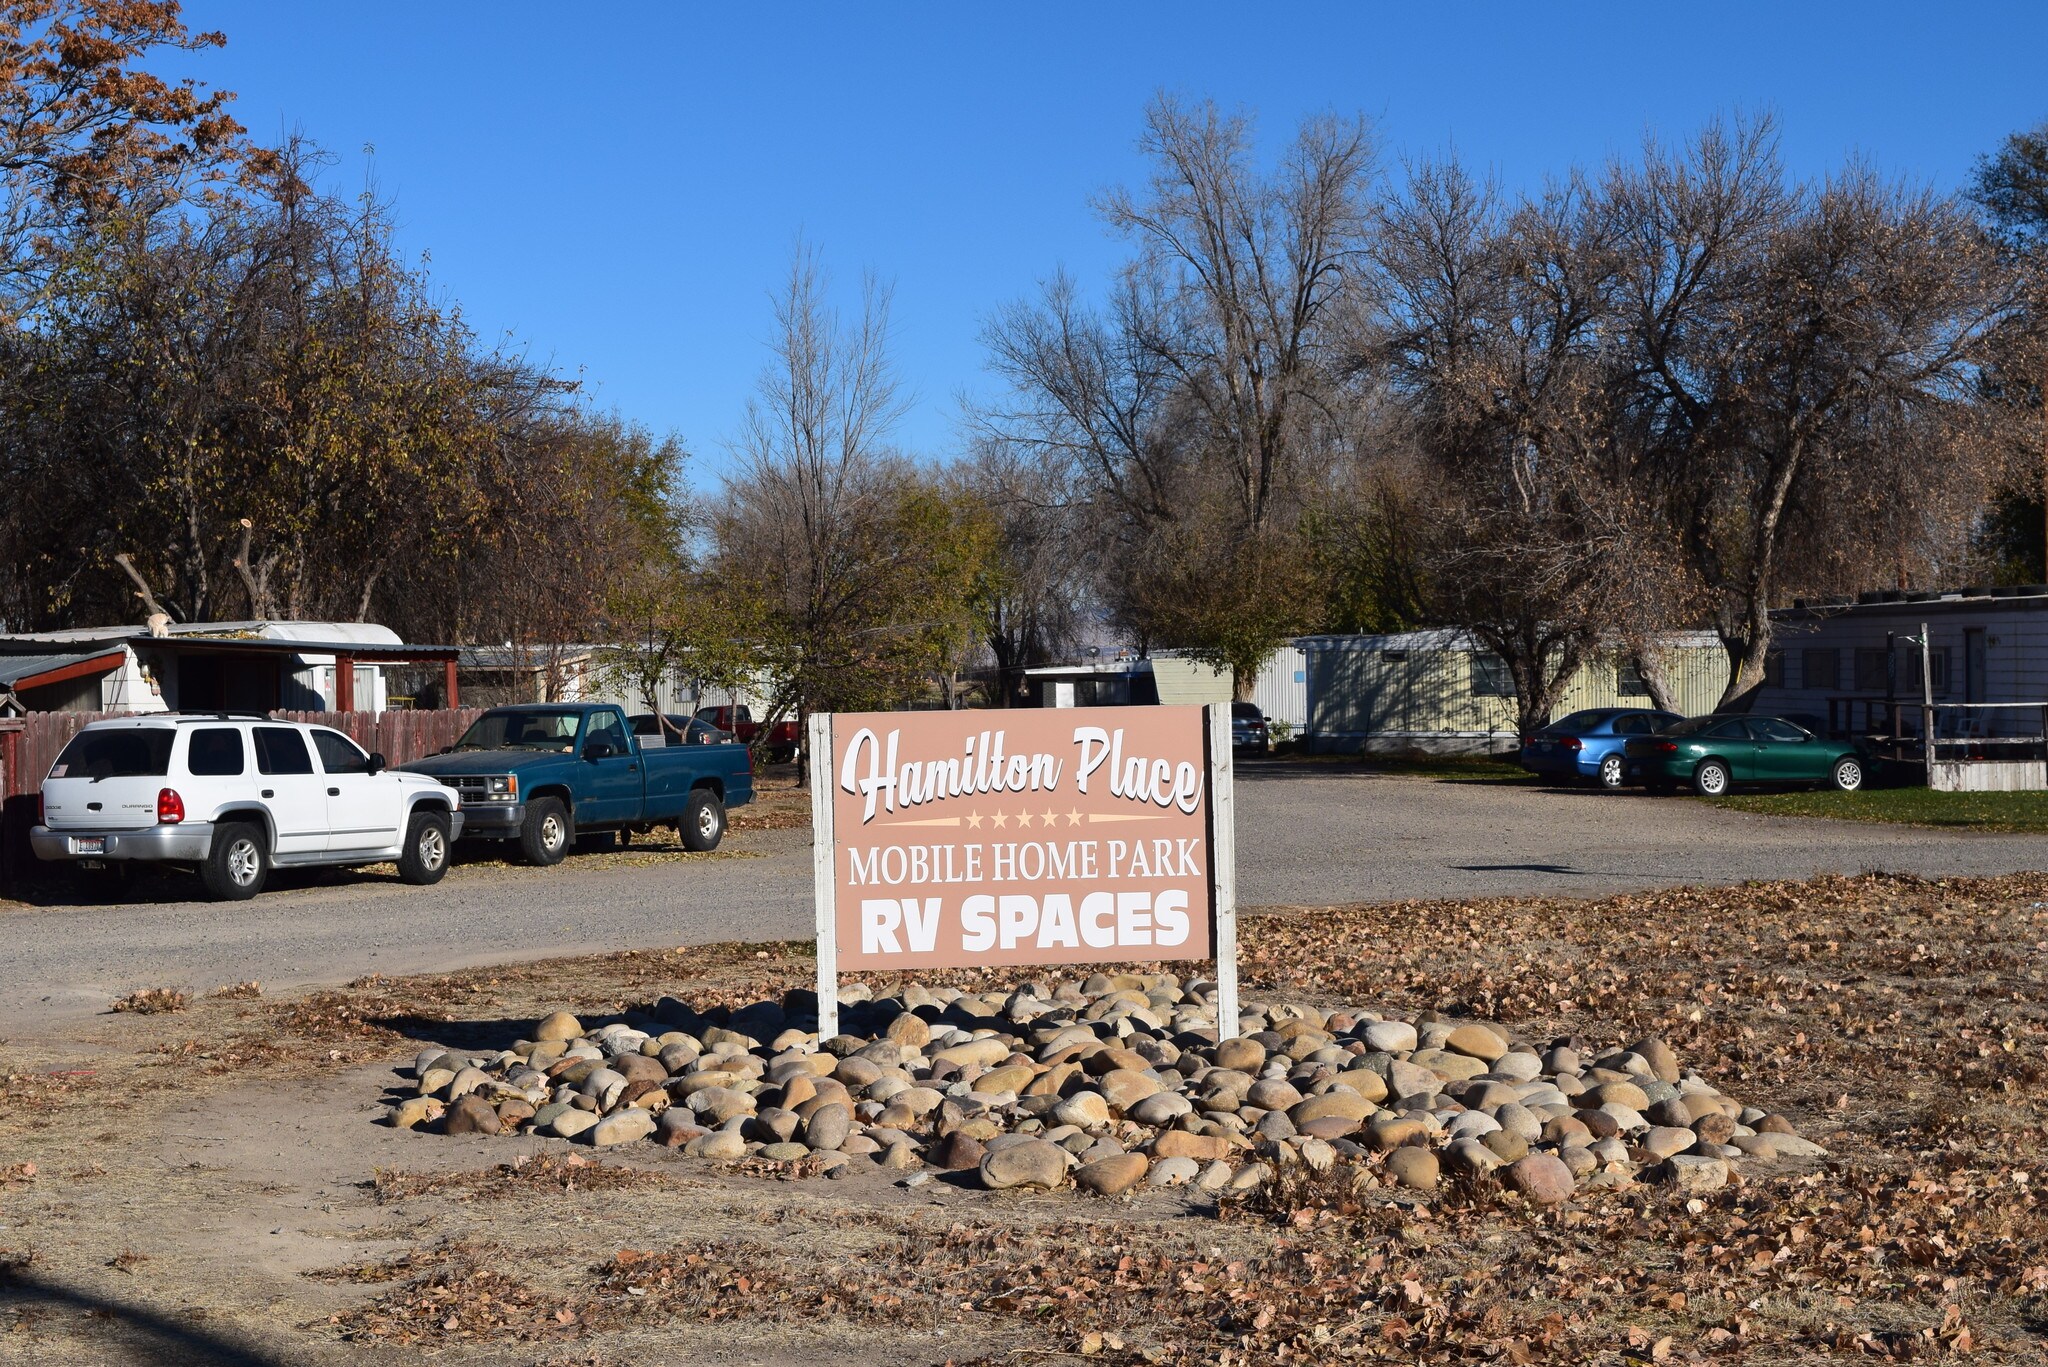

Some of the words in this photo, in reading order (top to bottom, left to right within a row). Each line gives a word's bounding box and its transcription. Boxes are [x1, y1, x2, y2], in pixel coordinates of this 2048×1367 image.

[841, 728, 1063, 826] Hamilton
[1073, 727, 1205, 815] Place
[848, 844, 983, 886] MOBILE
[992, 840, 1099, 881] HOME
[1108, 838, 1202, 878] PARK
[862, 897, 943, 954] RV
[961, 890, 1190, 952] SPACES
